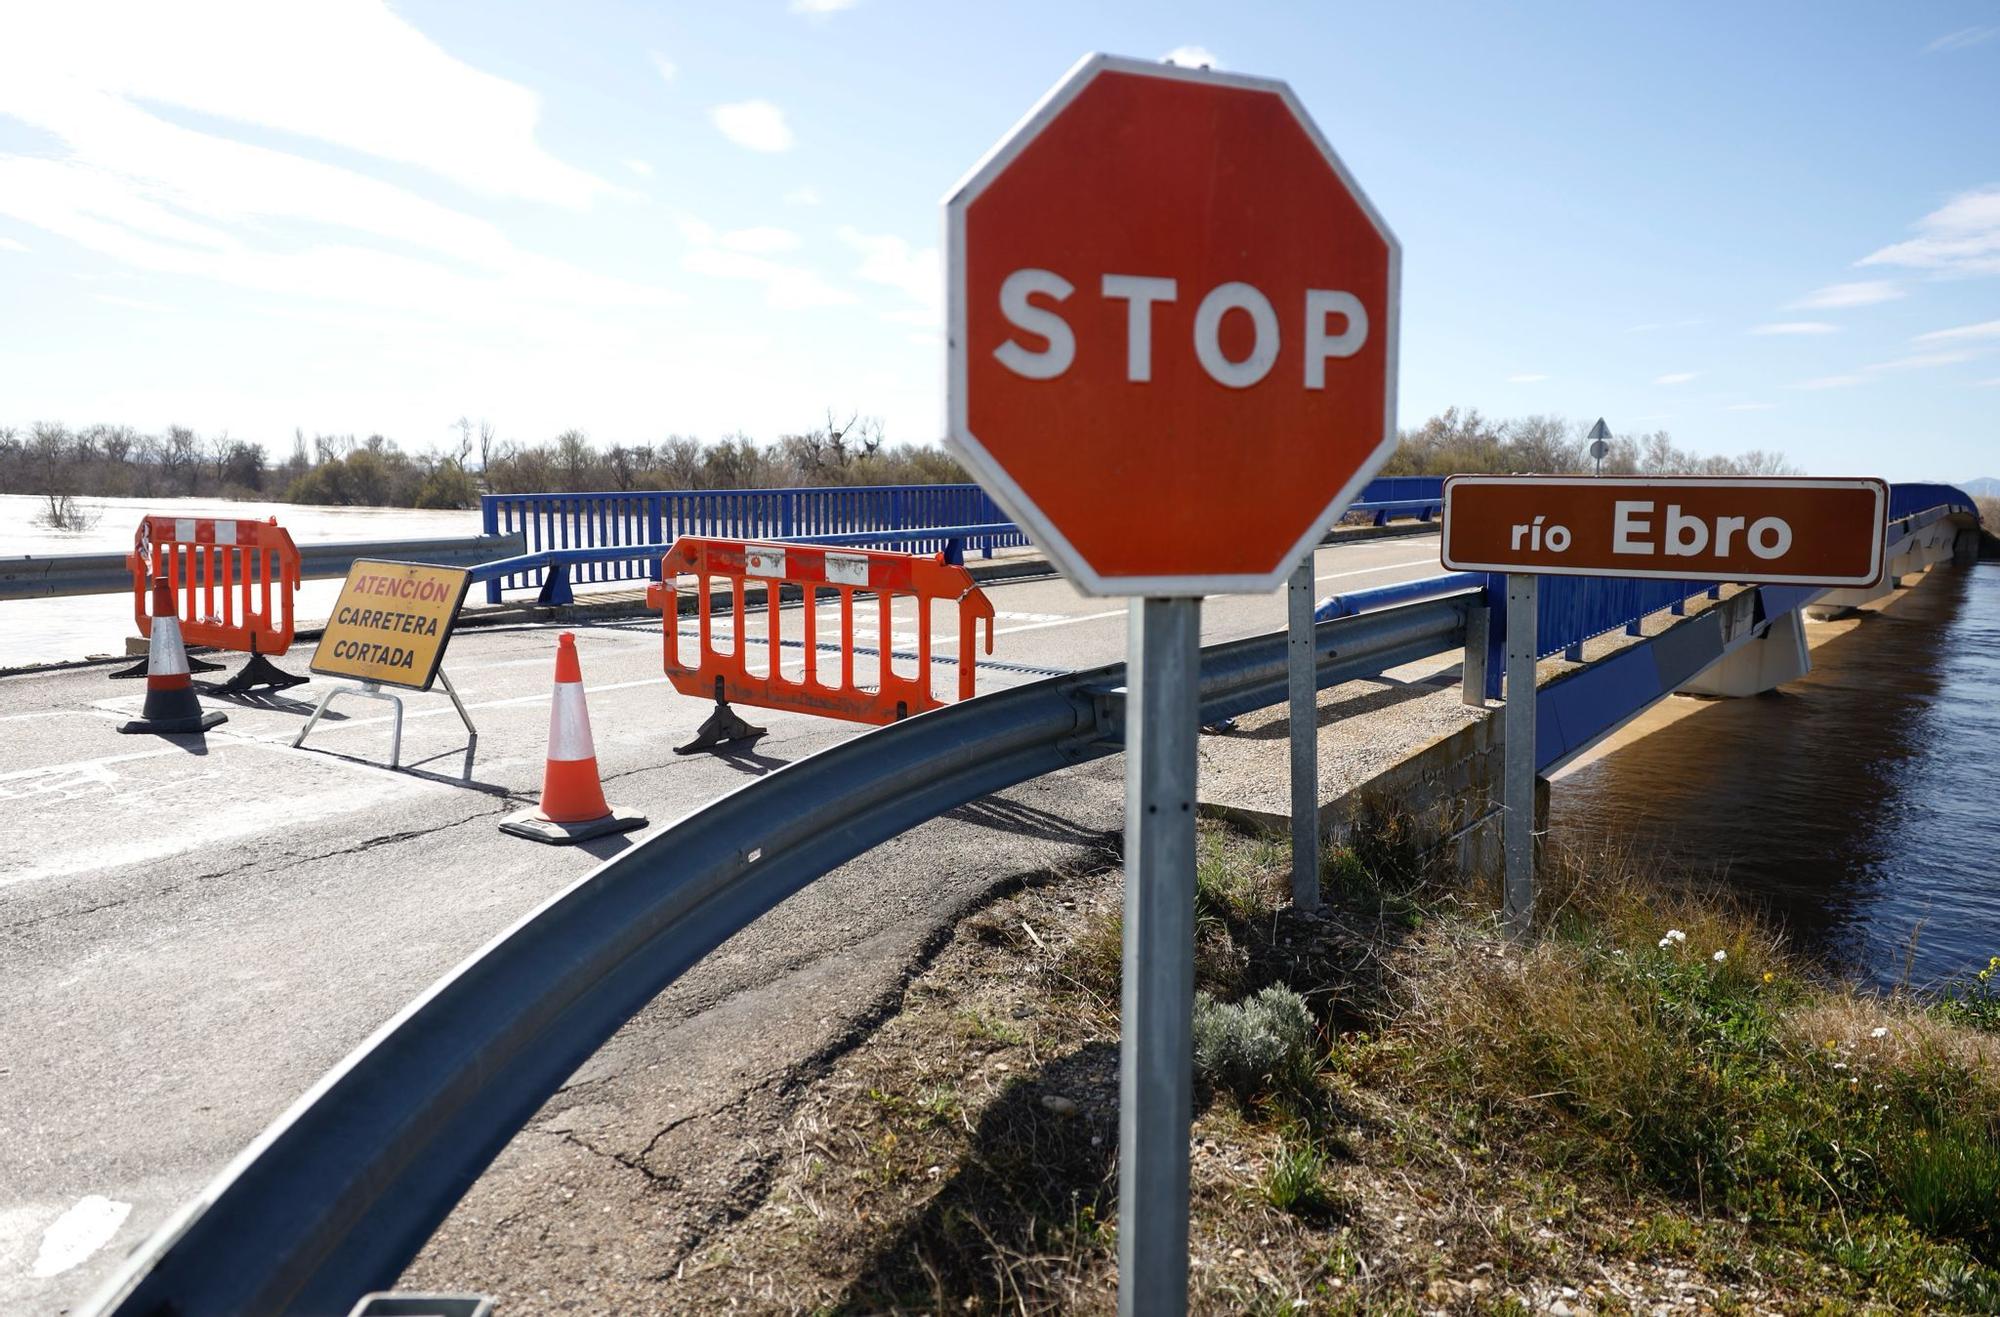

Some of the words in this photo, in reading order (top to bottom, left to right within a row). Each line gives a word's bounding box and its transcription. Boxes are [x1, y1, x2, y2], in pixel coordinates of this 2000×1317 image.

[993, 268, 1369, 390] STOP
[1511, 516, 1572, 553] río
[1612, 500, 1793, 560] Ebro
[354, 575, 450, 602] ATENCIÓN
[338, 607, 438, 636] CARRETERA
[333, 640, 414, 669] CORTADA
